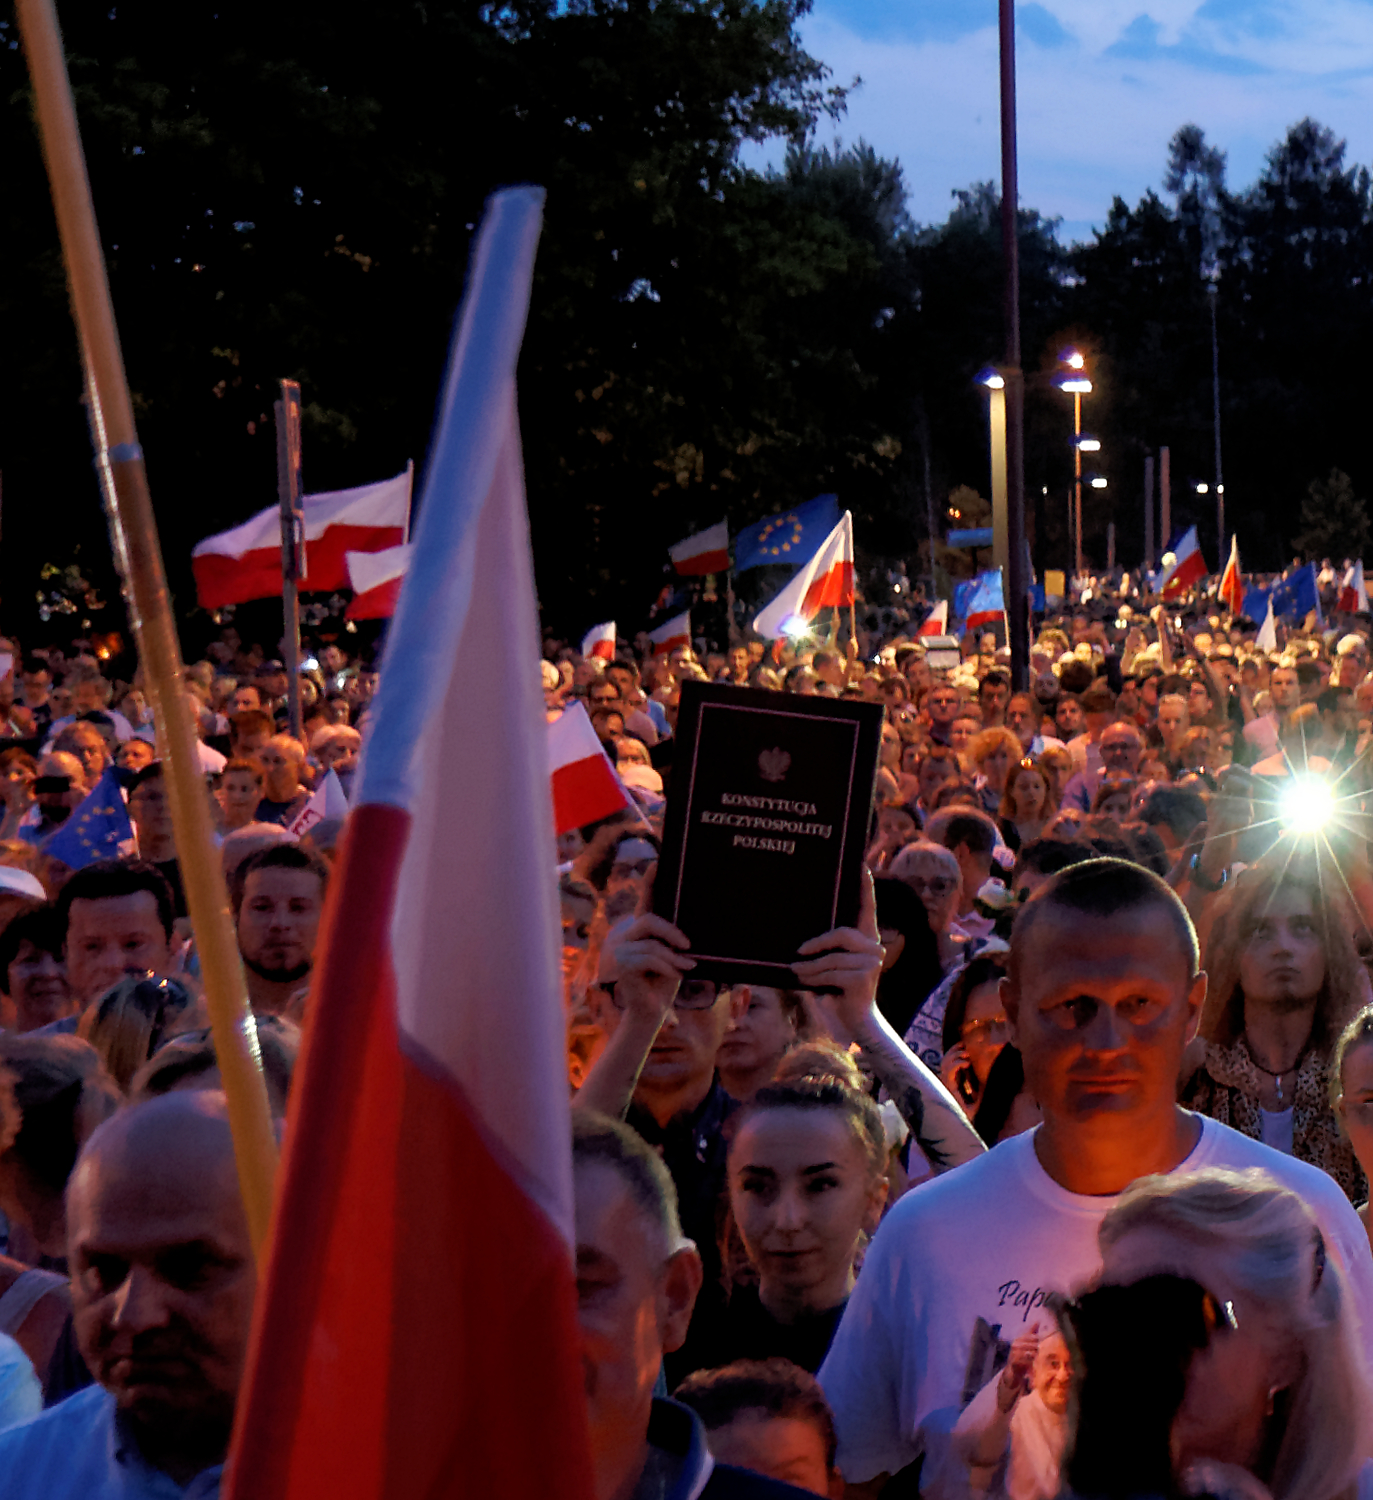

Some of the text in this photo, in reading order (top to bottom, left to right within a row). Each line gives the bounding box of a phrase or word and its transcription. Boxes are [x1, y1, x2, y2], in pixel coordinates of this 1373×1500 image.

[720, 792, 818, 817] KONSTYTUCJA
[700, 810, 833, 840] RZECZYPOSPOLITEJ
[732, 834, 797, 855] POLSKIEJ
